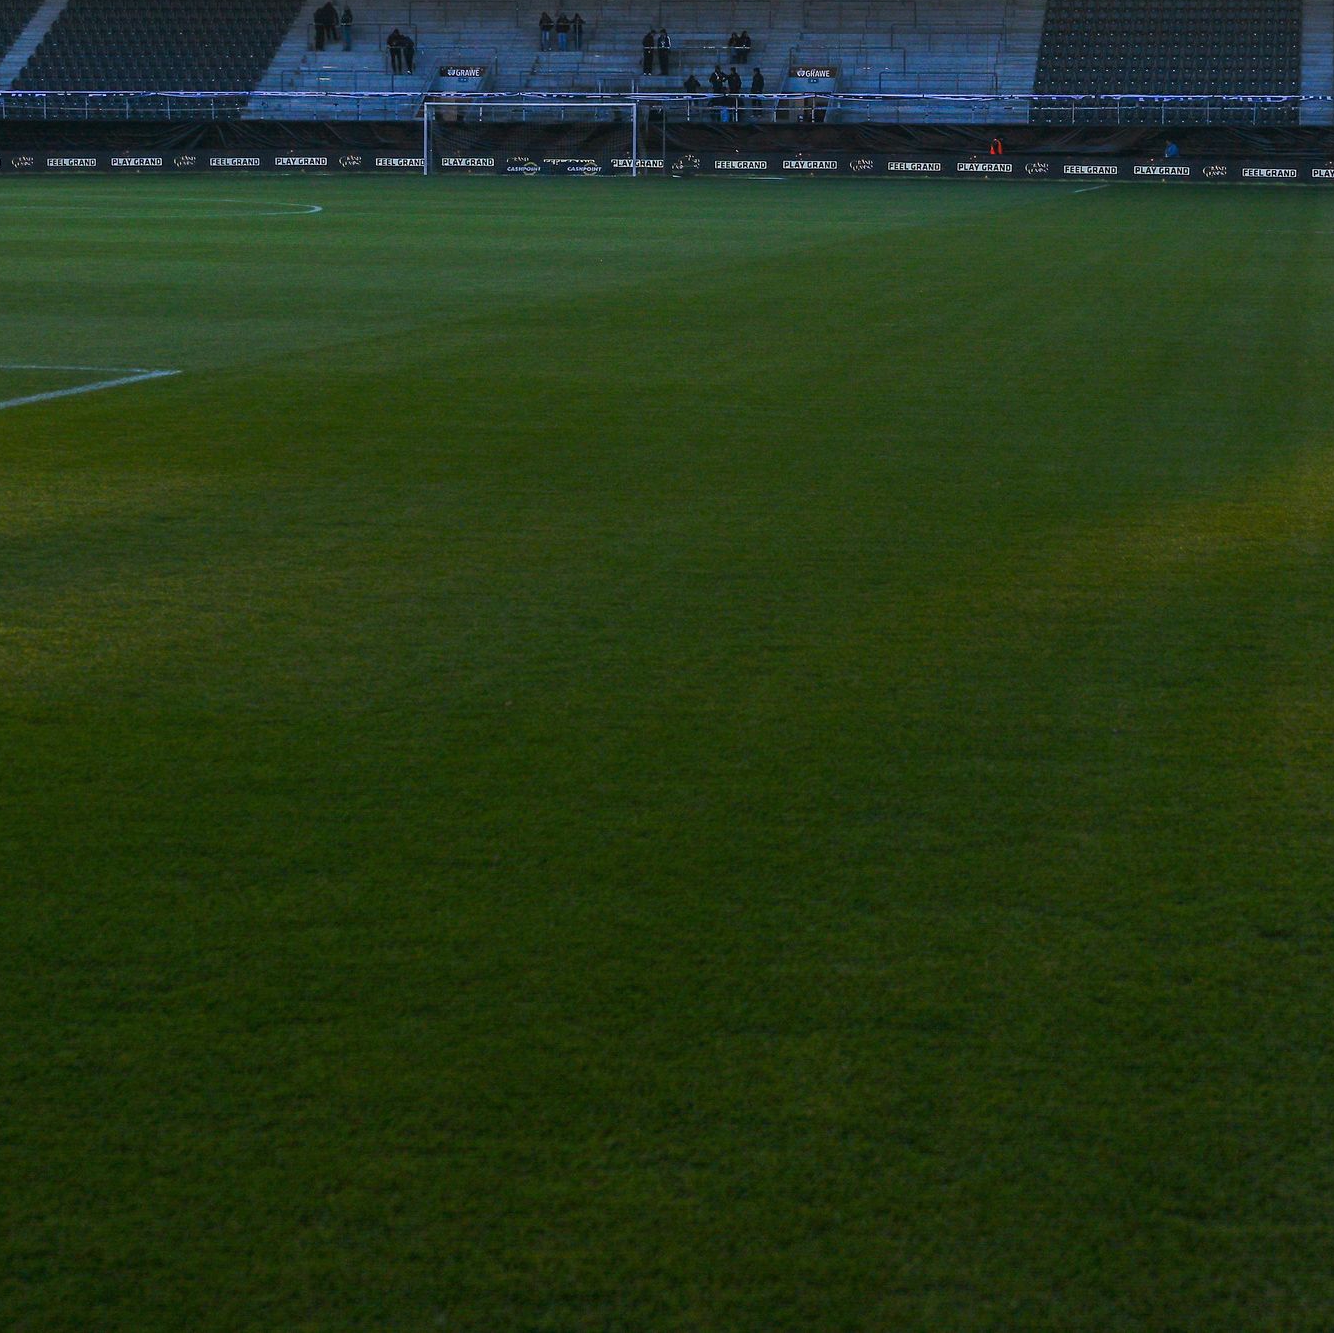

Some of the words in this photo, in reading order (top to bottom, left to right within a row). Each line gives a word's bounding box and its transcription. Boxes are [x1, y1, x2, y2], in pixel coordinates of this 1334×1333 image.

[456, 69, 480, 77] GRAWE
[806, 70, 830, 78] GRAWE
[716, 161, 737, 169] FEEL
[739, 161, 766, 169] GRAND
